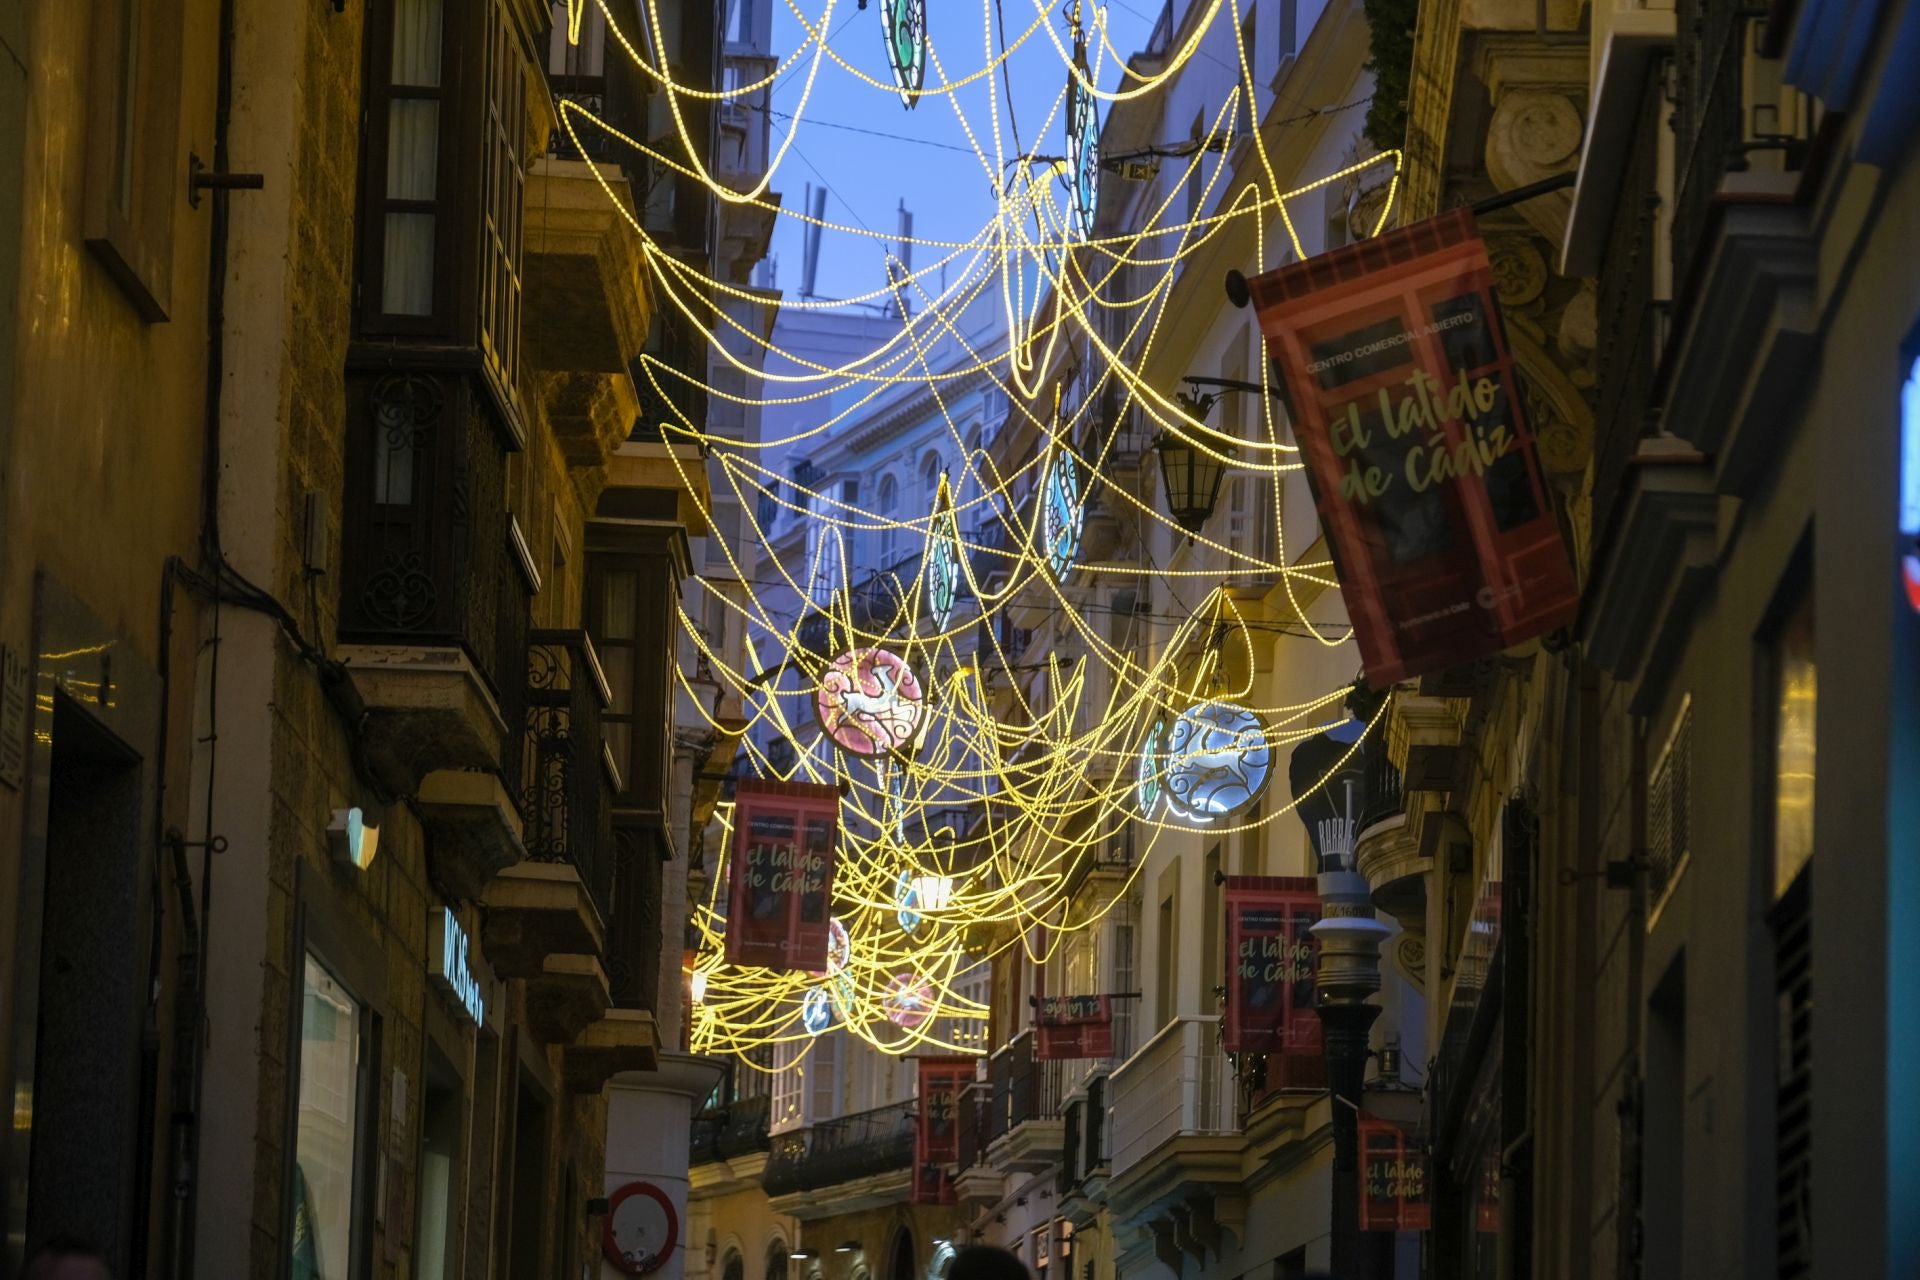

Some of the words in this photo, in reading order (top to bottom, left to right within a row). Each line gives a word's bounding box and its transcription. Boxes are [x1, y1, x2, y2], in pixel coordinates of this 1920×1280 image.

[1306, 350, 1353, 375] CENTRO
[1354, 328, 1420, 357] COMERCIAL
[1424, 312, 1474, 337] ABIERTO
[1329, 402, 1372, 457] El
[1377, 367, 1500, 440] latido
[1338, 458, 1393, 504] de
[1405, 423, 1514, 493] Cádiz
[746, 845, 765, 866] El
[770, 842, 824, 872] latido
[742, 867, 766, 888] de
[771, 871, 824, 896] Cádiz
[1239, 936, 1256, 959] El
[1261, 933, 1311, 962] latido
[1236, 959, 1260, 980] de
[1263, 961, 1312, 985] Cádiz
[1384, 1160, 1425, 1180] latido
